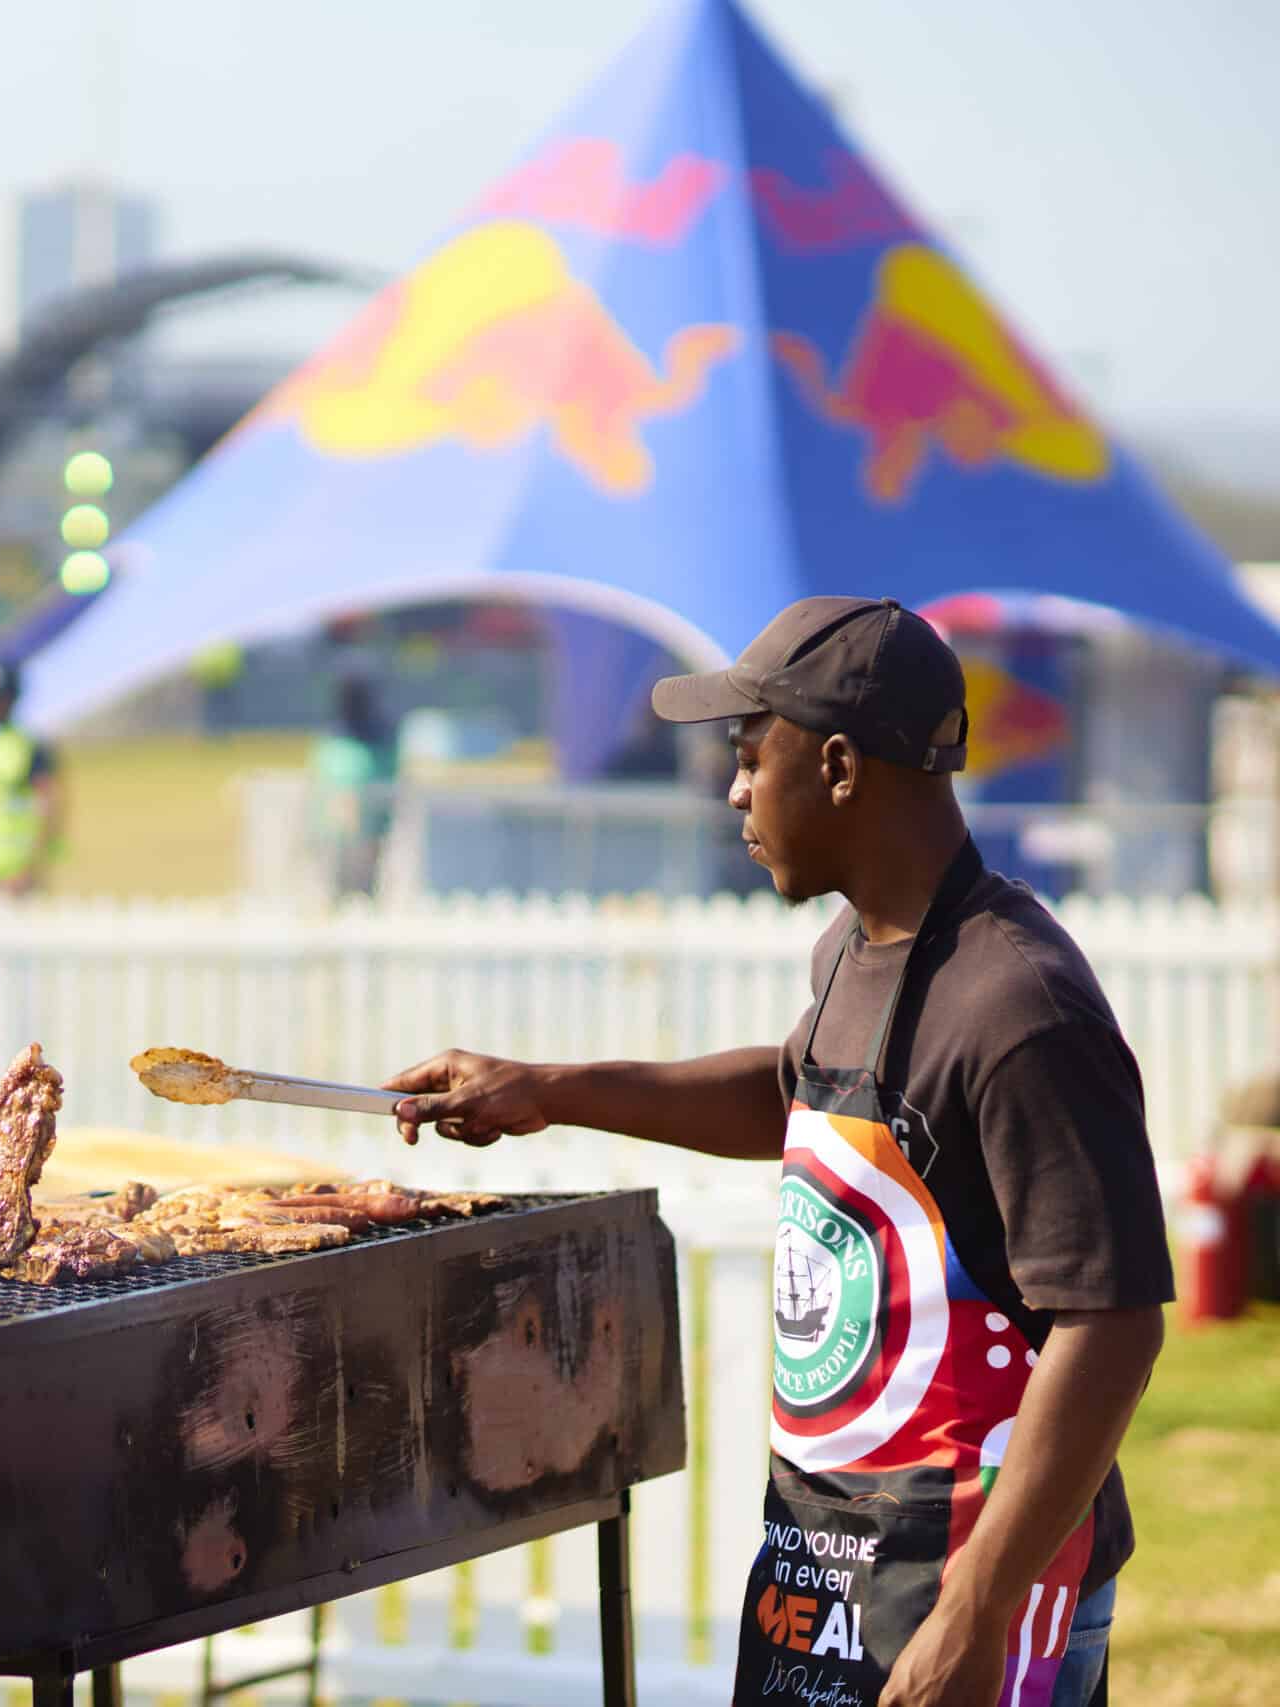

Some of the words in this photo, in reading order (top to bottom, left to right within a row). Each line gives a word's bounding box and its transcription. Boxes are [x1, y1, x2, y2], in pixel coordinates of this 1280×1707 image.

[806, 1318, 862, 1391] PEOPLE
[775, 1552, 791, 1584] in
[803, 1529, 858, 1561] YOUR
[756, 1583, 865, 1661] MEAL
